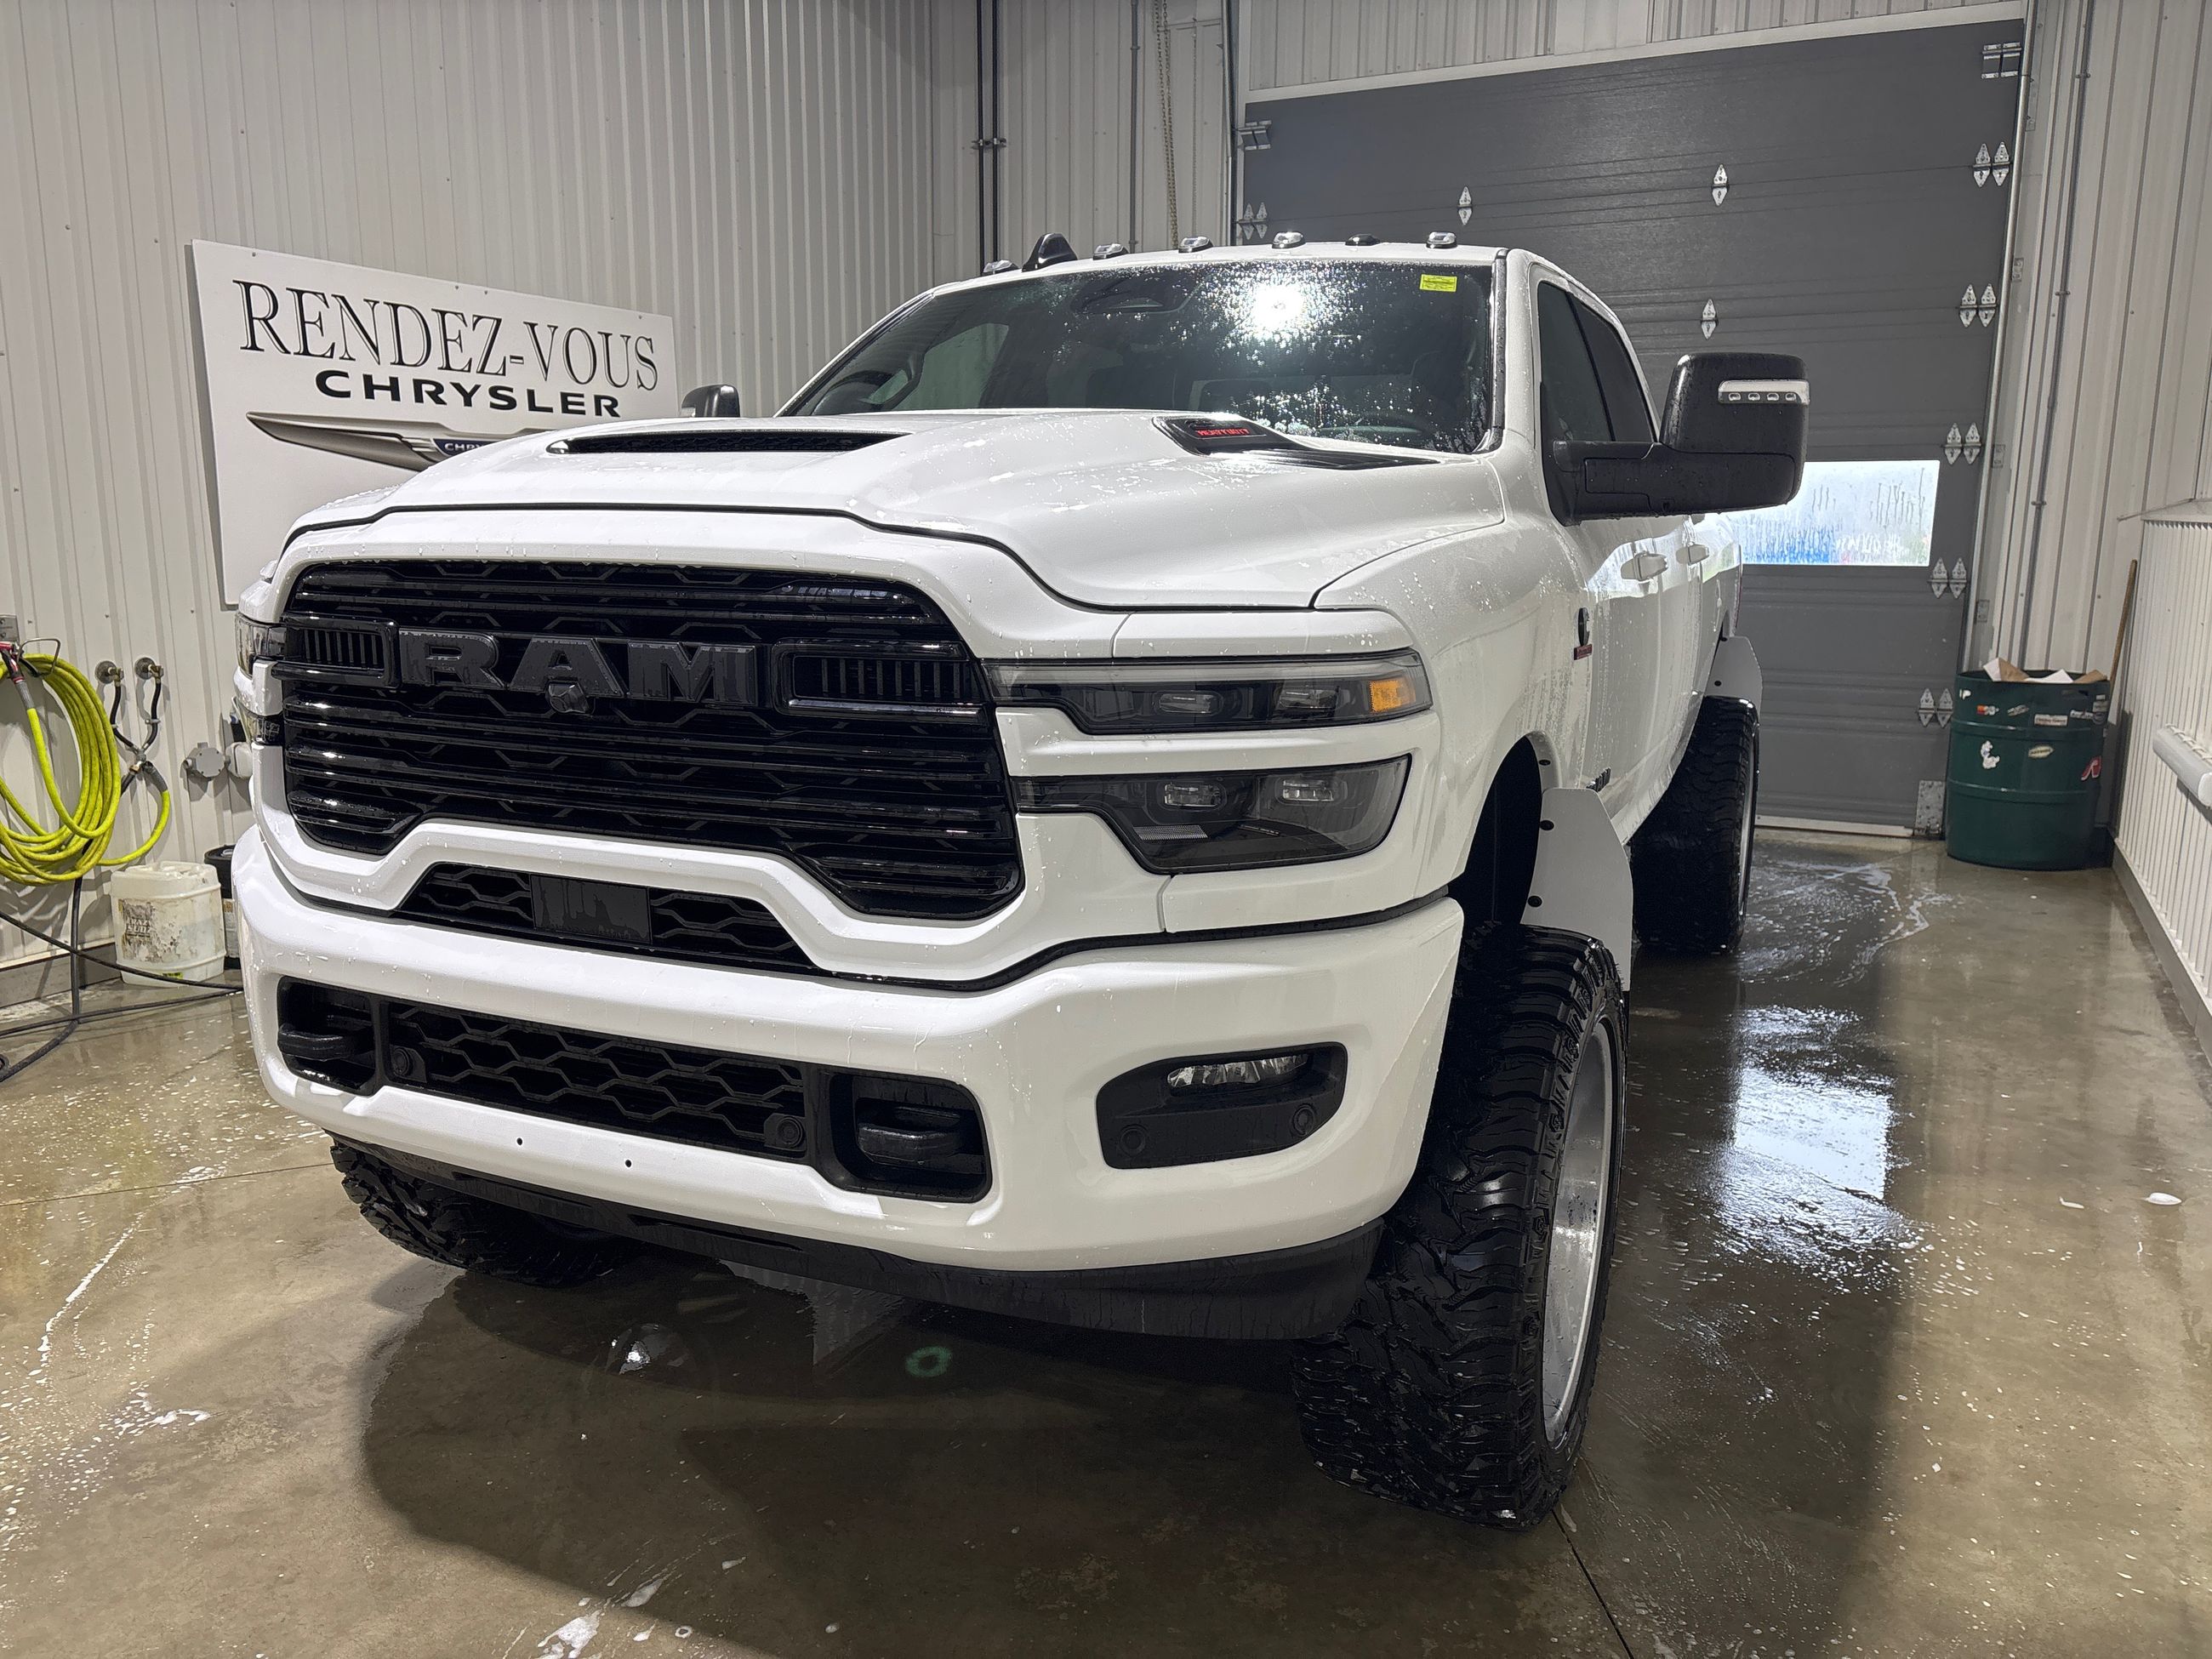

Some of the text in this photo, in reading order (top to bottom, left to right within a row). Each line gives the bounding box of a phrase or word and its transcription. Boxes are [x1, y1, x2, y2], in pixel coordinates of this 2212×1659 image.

[232, 279, 658, 391] RENDEZ-VOUS
[316, 369, 620, 418] CHRYSLER
[398, 628, 758, 706] RAM
